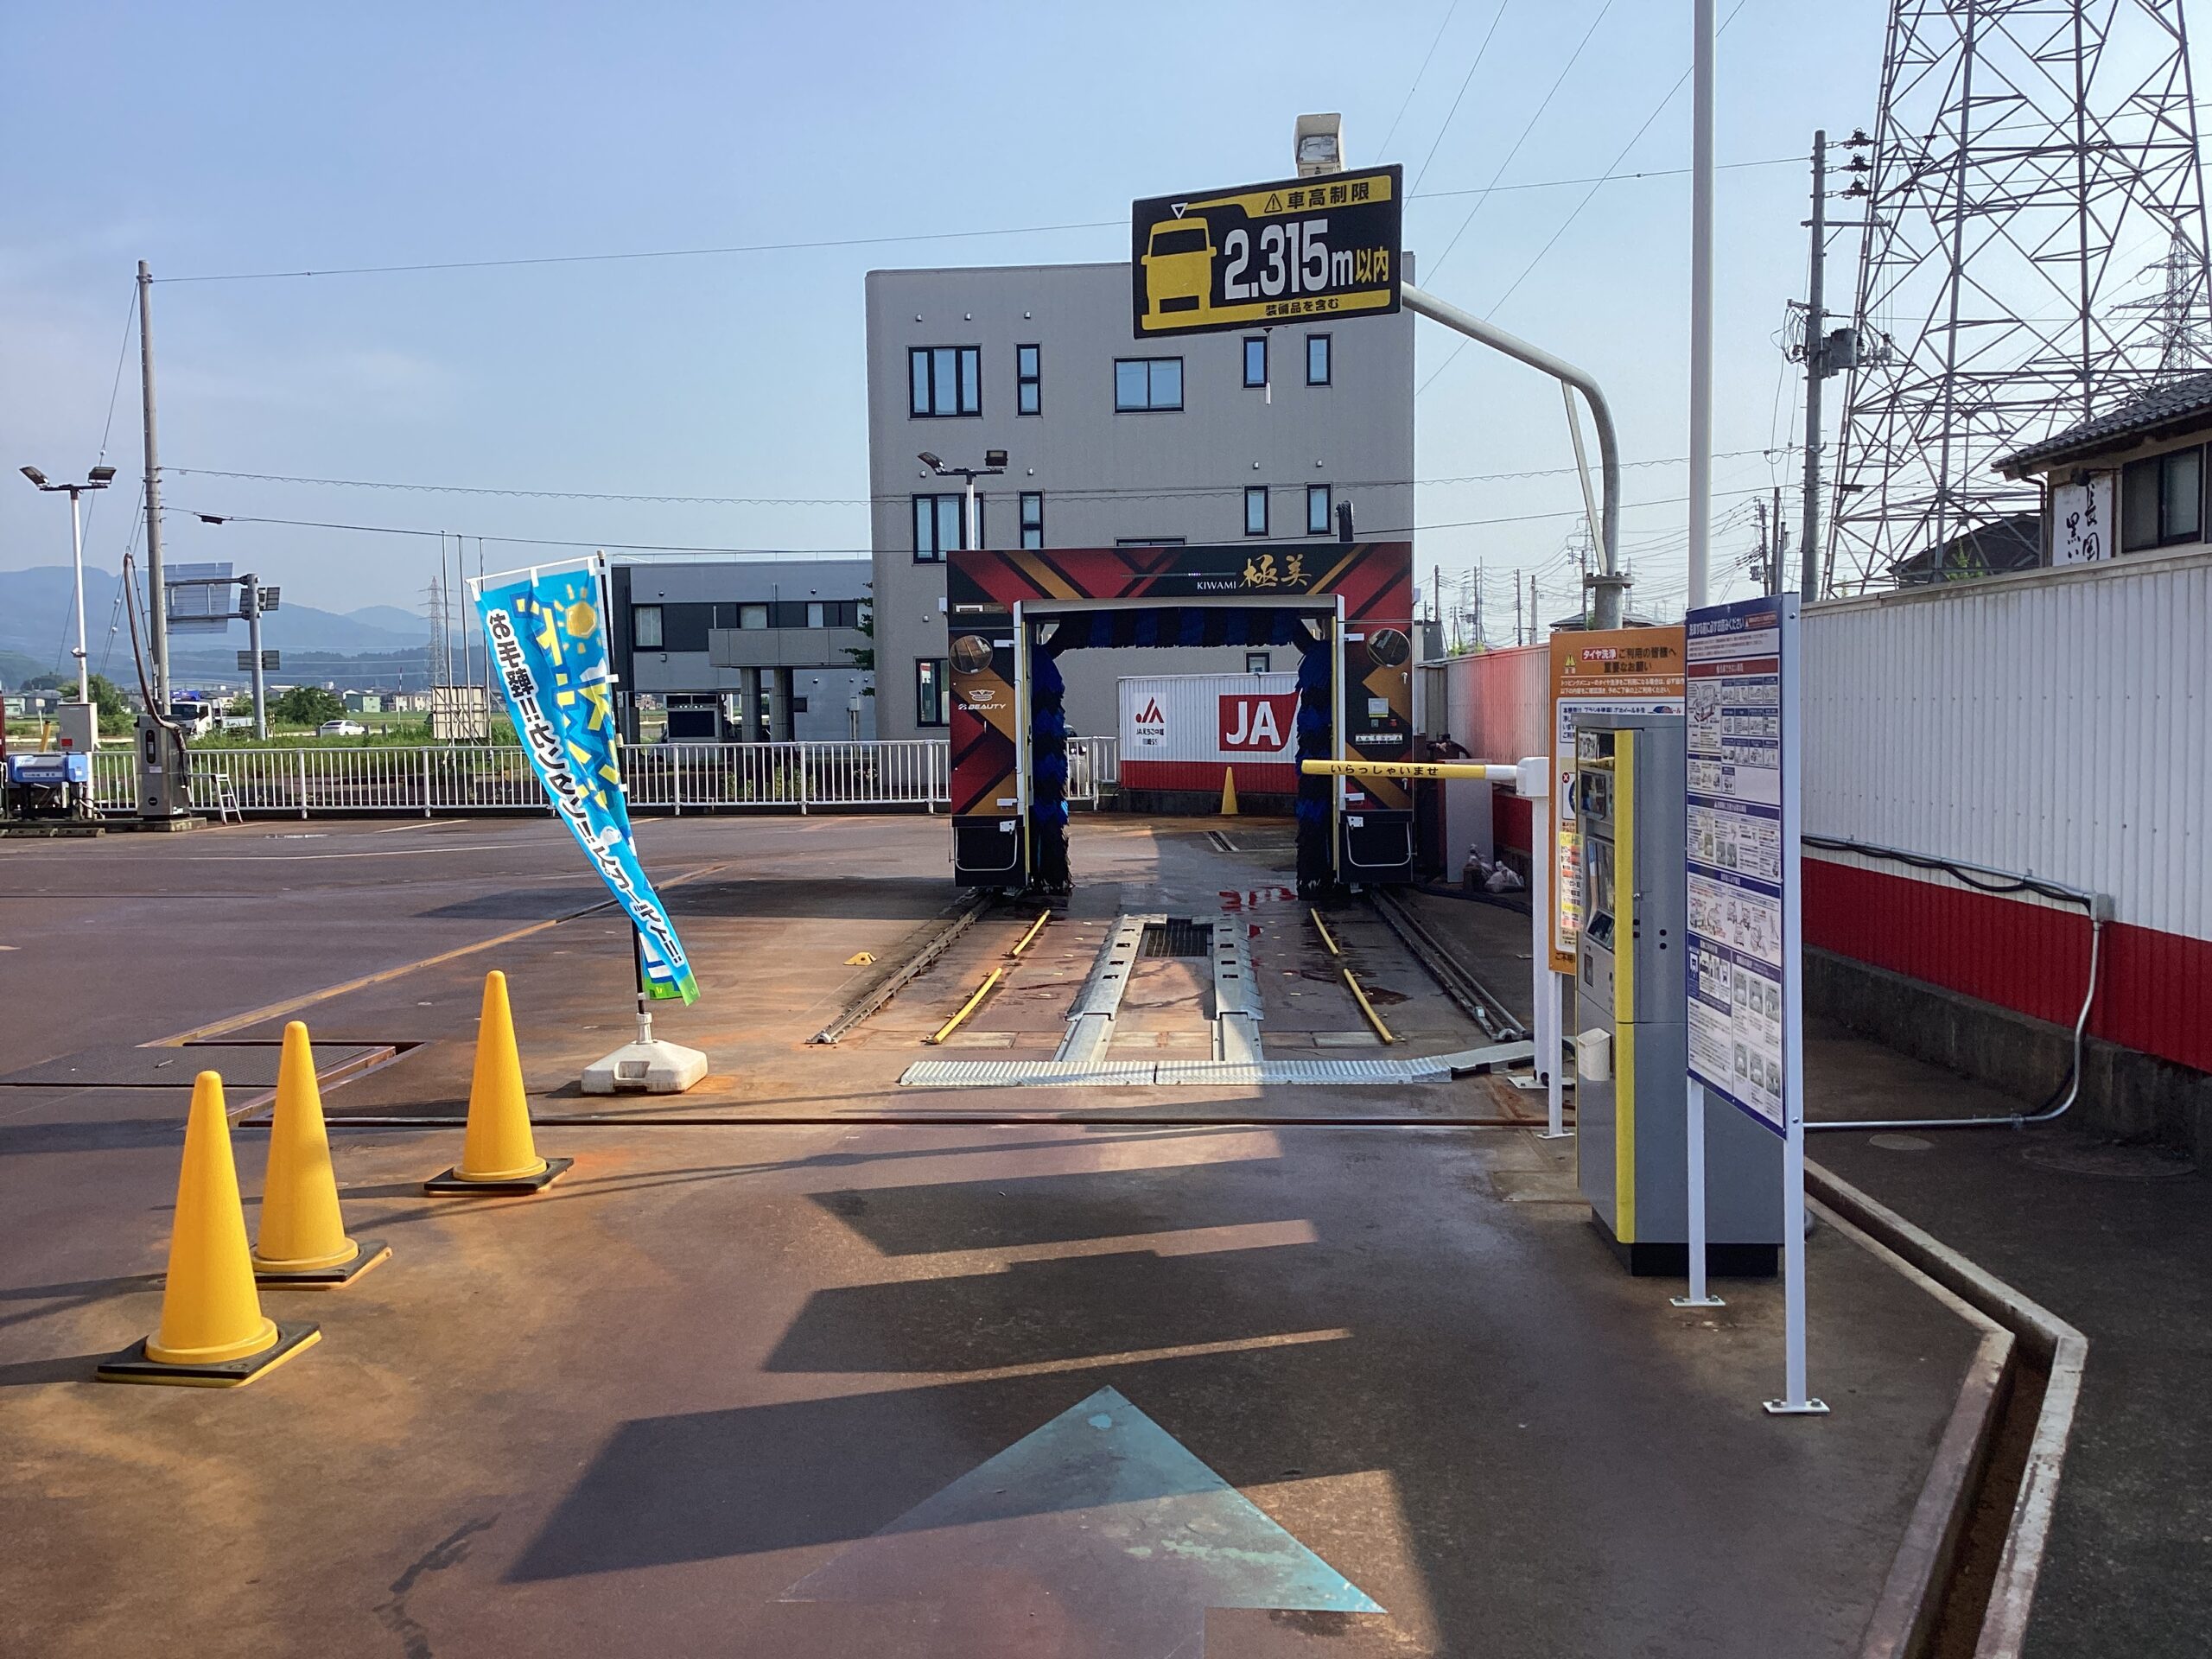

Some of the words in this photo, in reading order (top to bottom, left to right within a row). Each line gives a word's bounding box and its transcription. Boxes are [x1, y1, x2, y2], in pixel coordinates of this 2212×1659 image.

[1287, 182, 1370, 210] 車高制限
[1264, 297, 1339, 316] 装備品を含む
[1197, 581, 1236, 590] KIWAMI
[1239, 554, 1313, 588] 極美
[1226, 701, 1281, 746] JA
[1331, 764, 1439, 776] いらっしゃいませ
